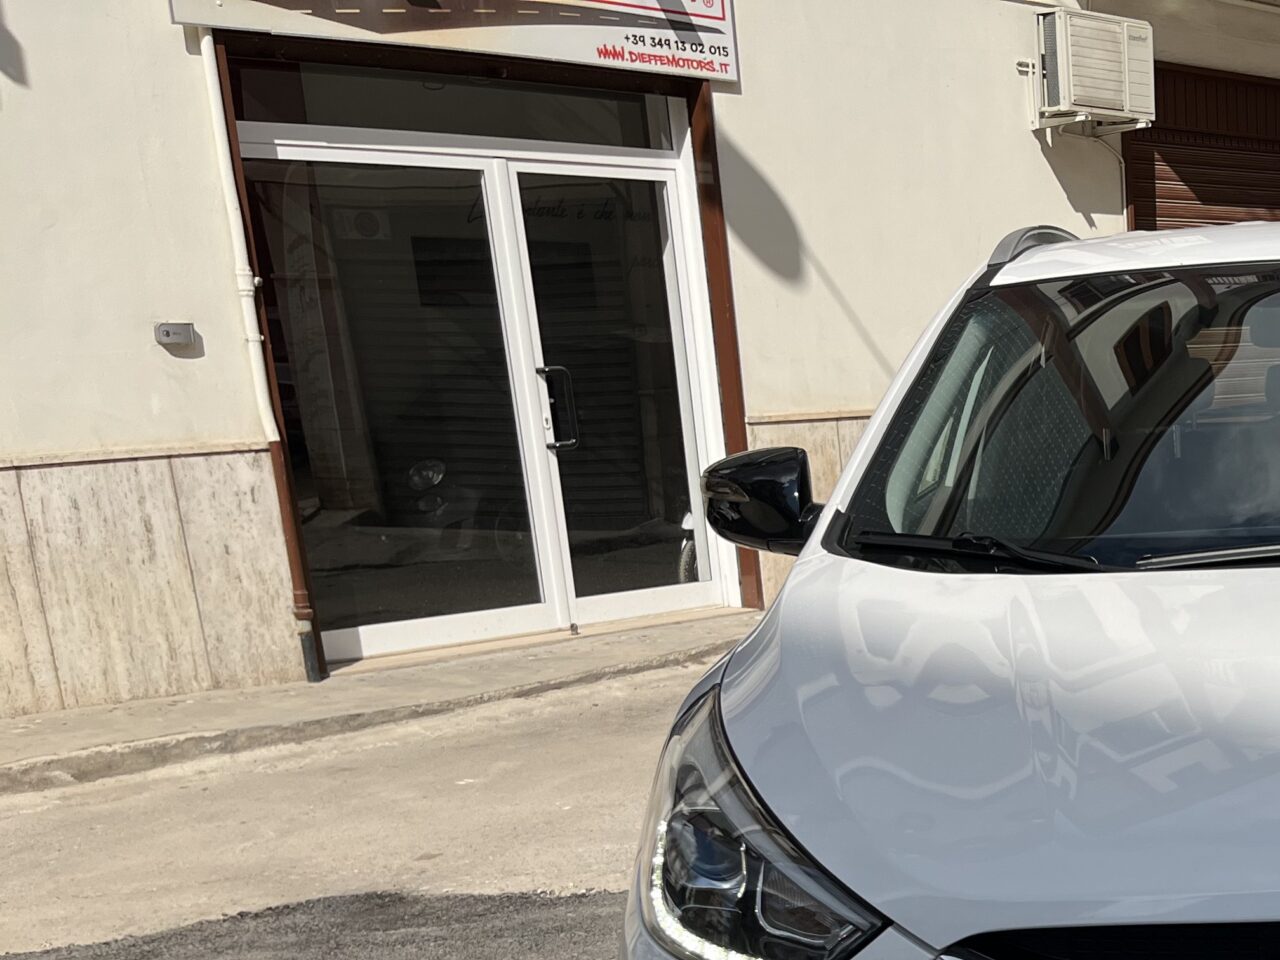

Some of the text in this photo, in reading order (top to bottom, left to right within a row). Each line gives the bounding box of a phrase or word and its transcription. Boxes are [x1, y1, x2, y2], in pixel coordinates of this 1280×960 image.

[624, 34, 729, 57] +39 349 13 02 015
